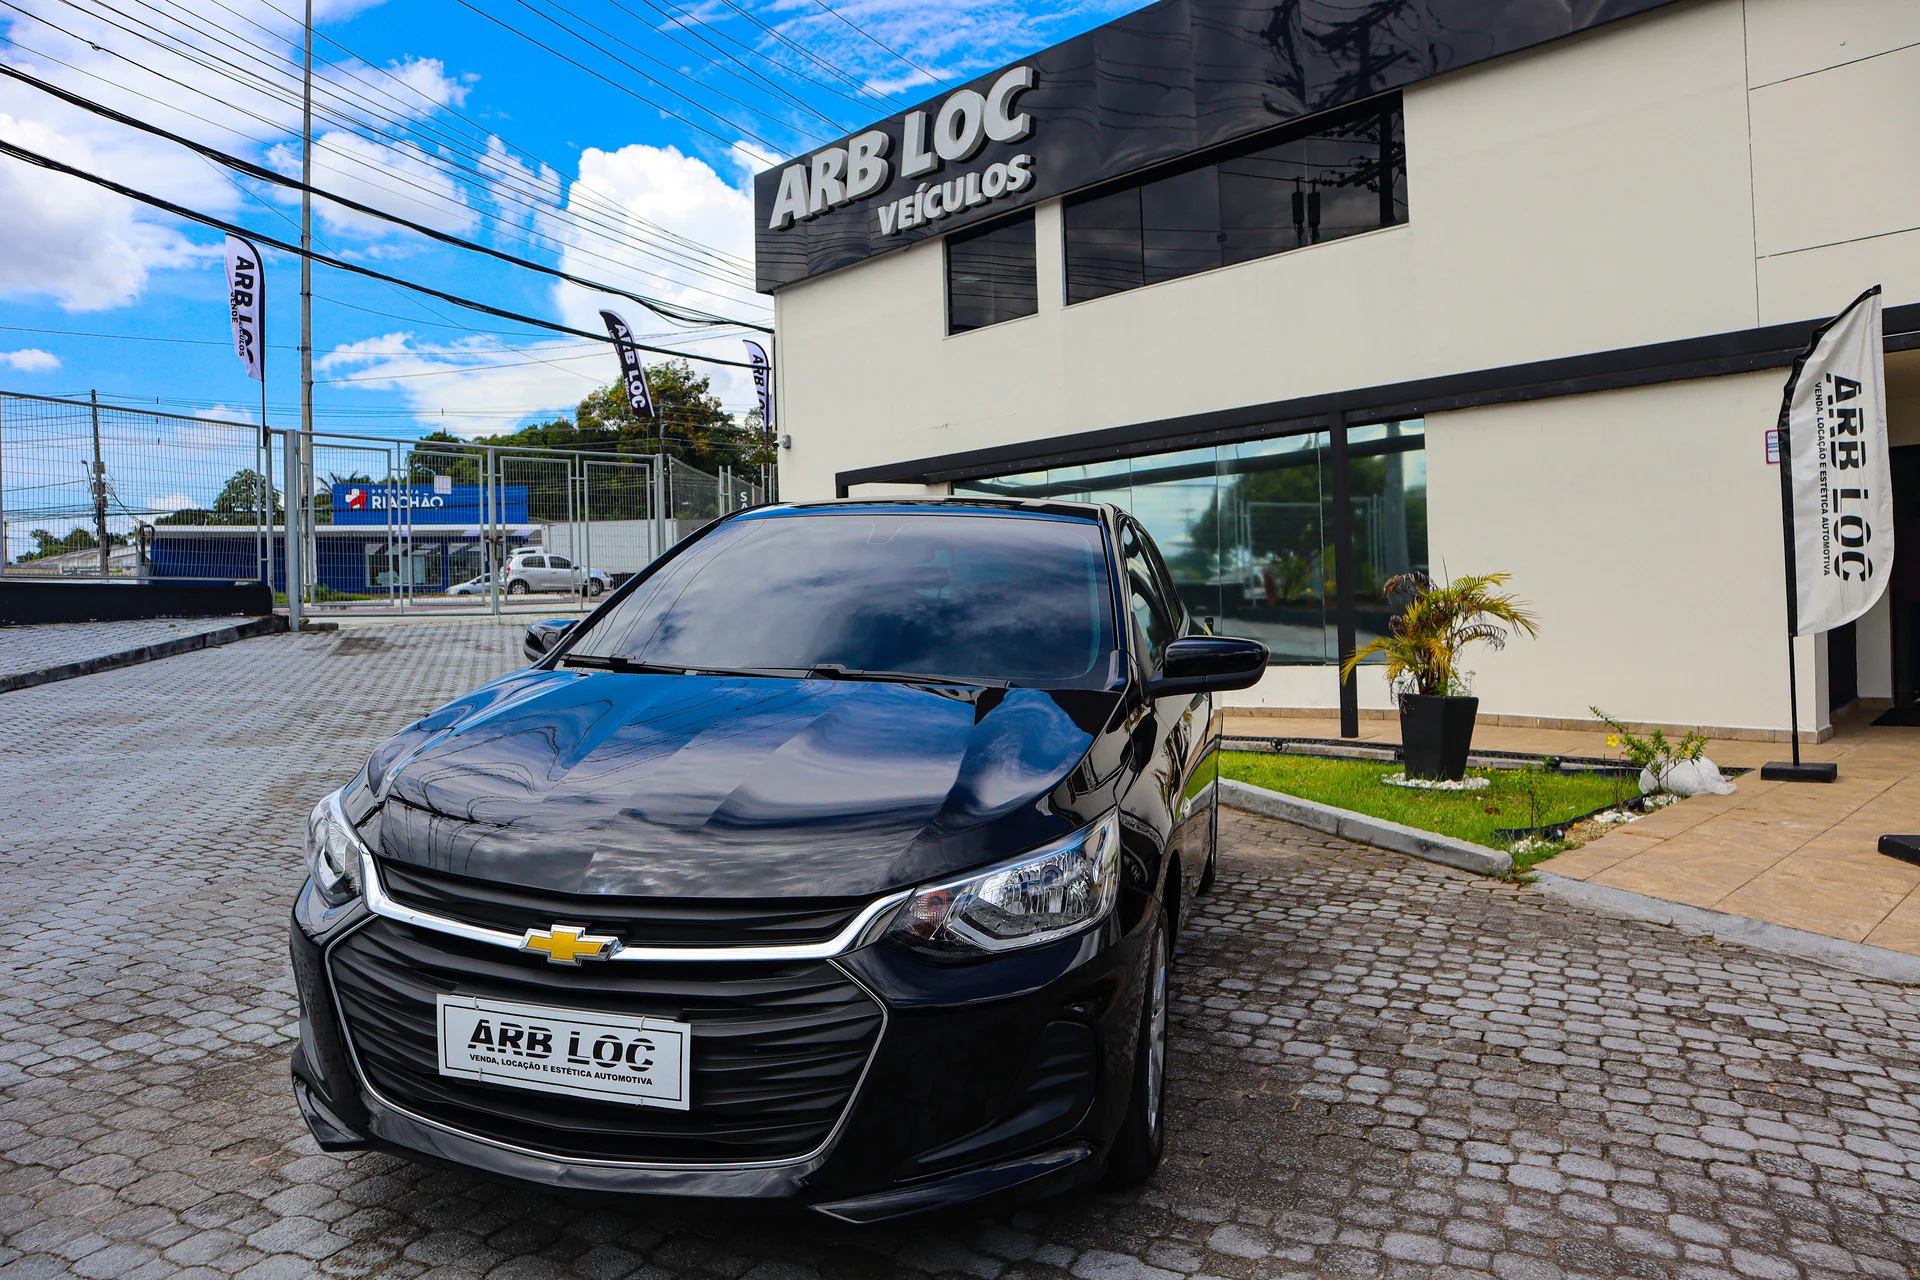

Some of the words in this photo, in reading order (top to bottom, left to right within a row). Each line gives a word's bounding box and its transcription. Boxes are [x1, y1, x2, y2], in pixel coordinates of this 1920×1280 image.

[768, 130, 889, 231] ARB
[901, 66, 1033, 178] LOC
[878, 153, 1032, 236] VEÍCULOS
[234, 255, 255, 307] ARB
[628, 369, 646, 409] LOC
[753, 354, 765, 387] ARB
[1814, 381, 1822, 415] VENDA,
[1826, 372, 1868, 470] ARB
[1817, 416, 1827, 460] LOCAÇÃO
[371, 493, 444, 510] RIACHÃO
[1819, 470, 1829, 514] ESTÉTICA
[1821, 517, 1831, 577] AUTOMOTIVA
[1832, 488, 1874, 582] LOC
[467, 1018, 553, 1059] ARB
[567, 1030, 656, 1072] LOC
[469, 1053, 500, 1066] VENDA,
[501, 1058, 541, 1072] LOCAÇÃO
[550, 1065, 592, 1079] ESTÉTICA
[594, 1072, 653, 1086] AUTOMOTIVA
